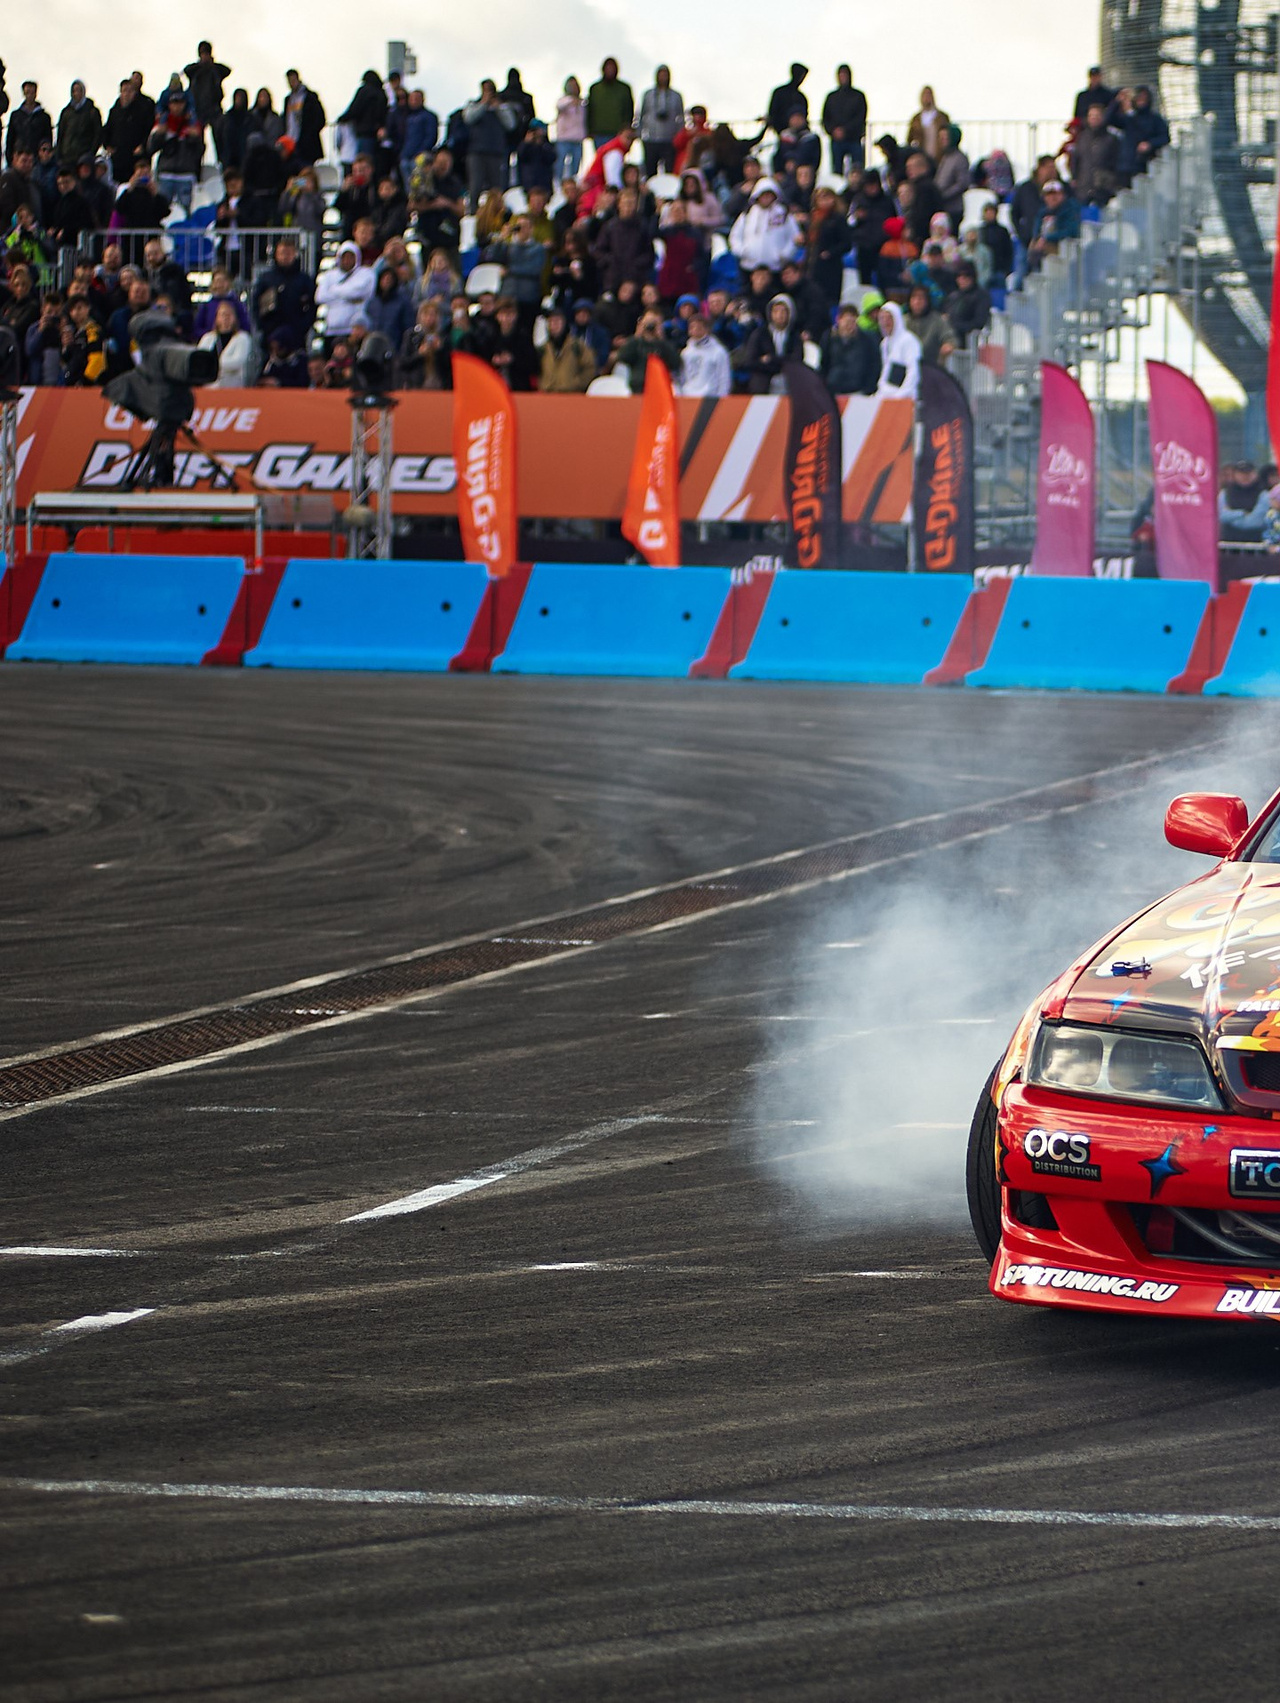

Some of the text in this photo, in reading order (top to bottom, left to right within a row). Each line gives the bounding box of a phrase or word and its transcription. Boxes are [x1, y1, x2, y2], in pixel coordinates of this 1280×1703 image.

[1024, 1129, 1089, 1164] OCS
[1034, 1161, 1099, 1178] DISTRIBUTION
[1000, 1265, 1180, 1302] SPBTUNING.RU
